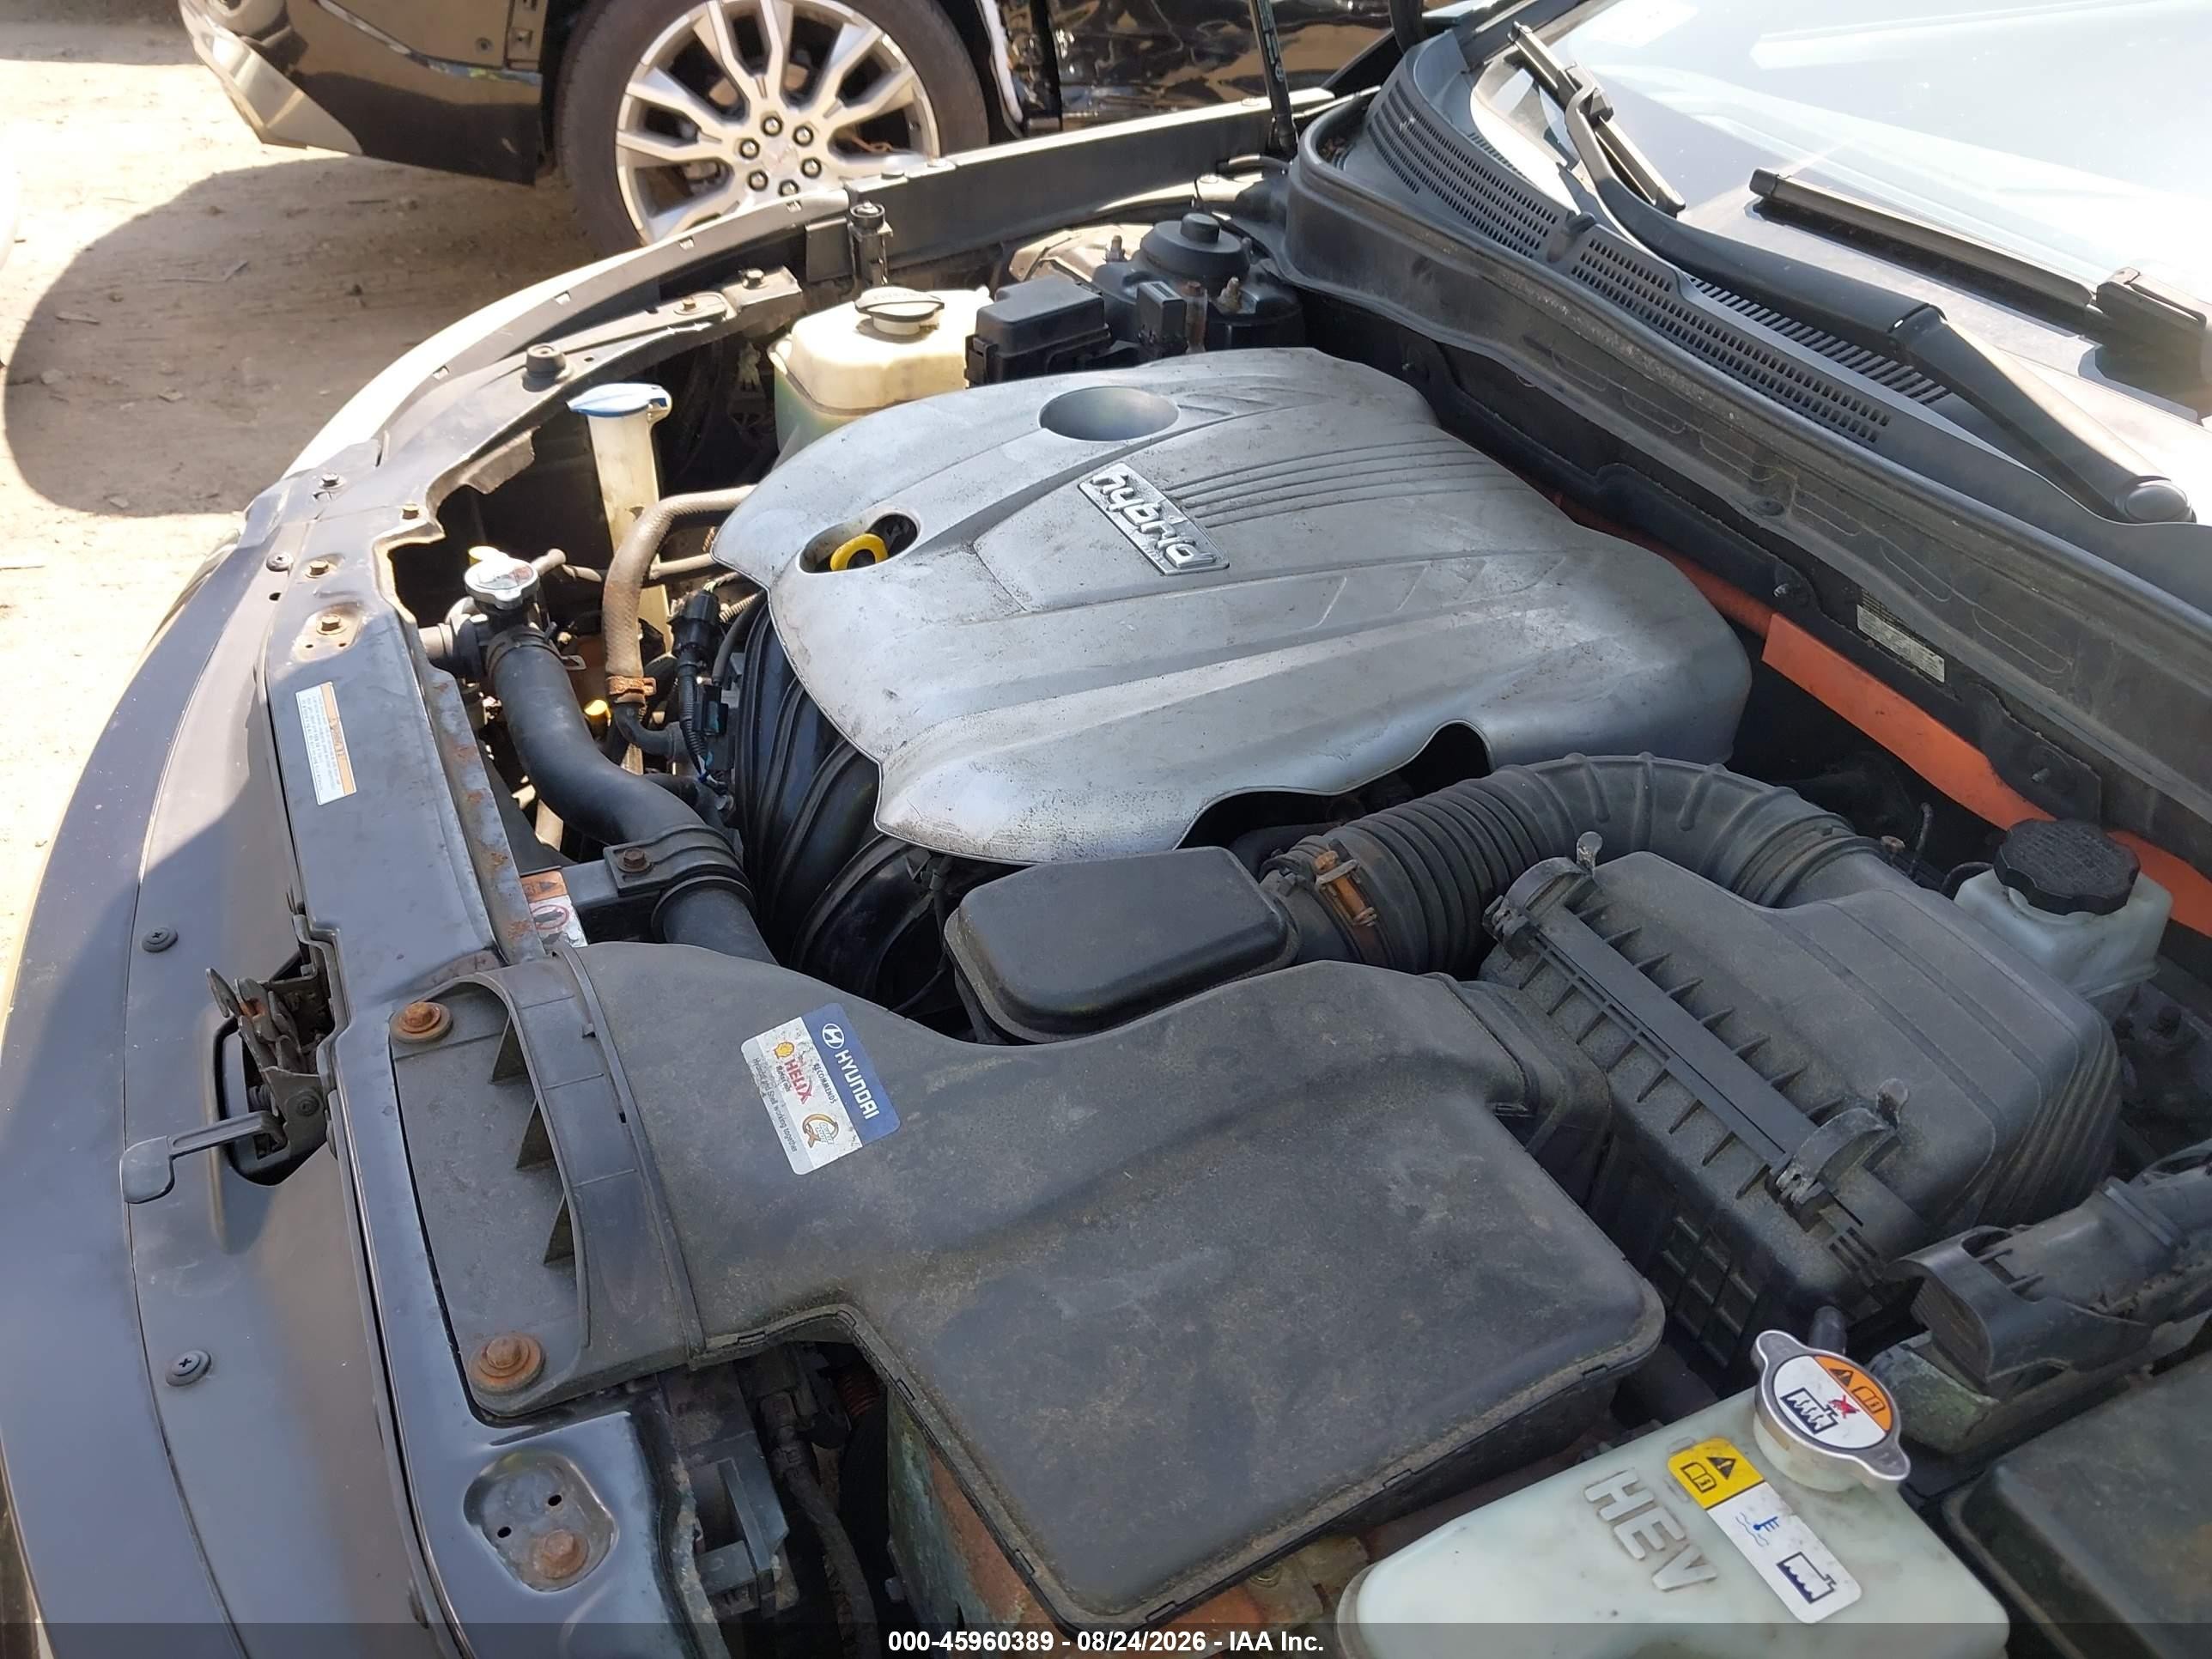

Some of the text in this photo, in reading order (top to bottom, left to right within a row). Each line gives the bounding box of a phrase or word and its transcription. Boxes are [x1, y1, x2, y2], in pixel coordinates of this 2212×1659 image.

[1090, 473, 1217, 568] hybrid
[785, 1058, 814, 1104] HELIX
[813, 1061, 836, 1104] RECOMMENDS
[835, 1049, 880, 1120] HYUNDAI
[774, 1105, 787, 1128] working
[783, 1127, 797, 1152] together
[1584, 1469, 1717, 1593] HEV
